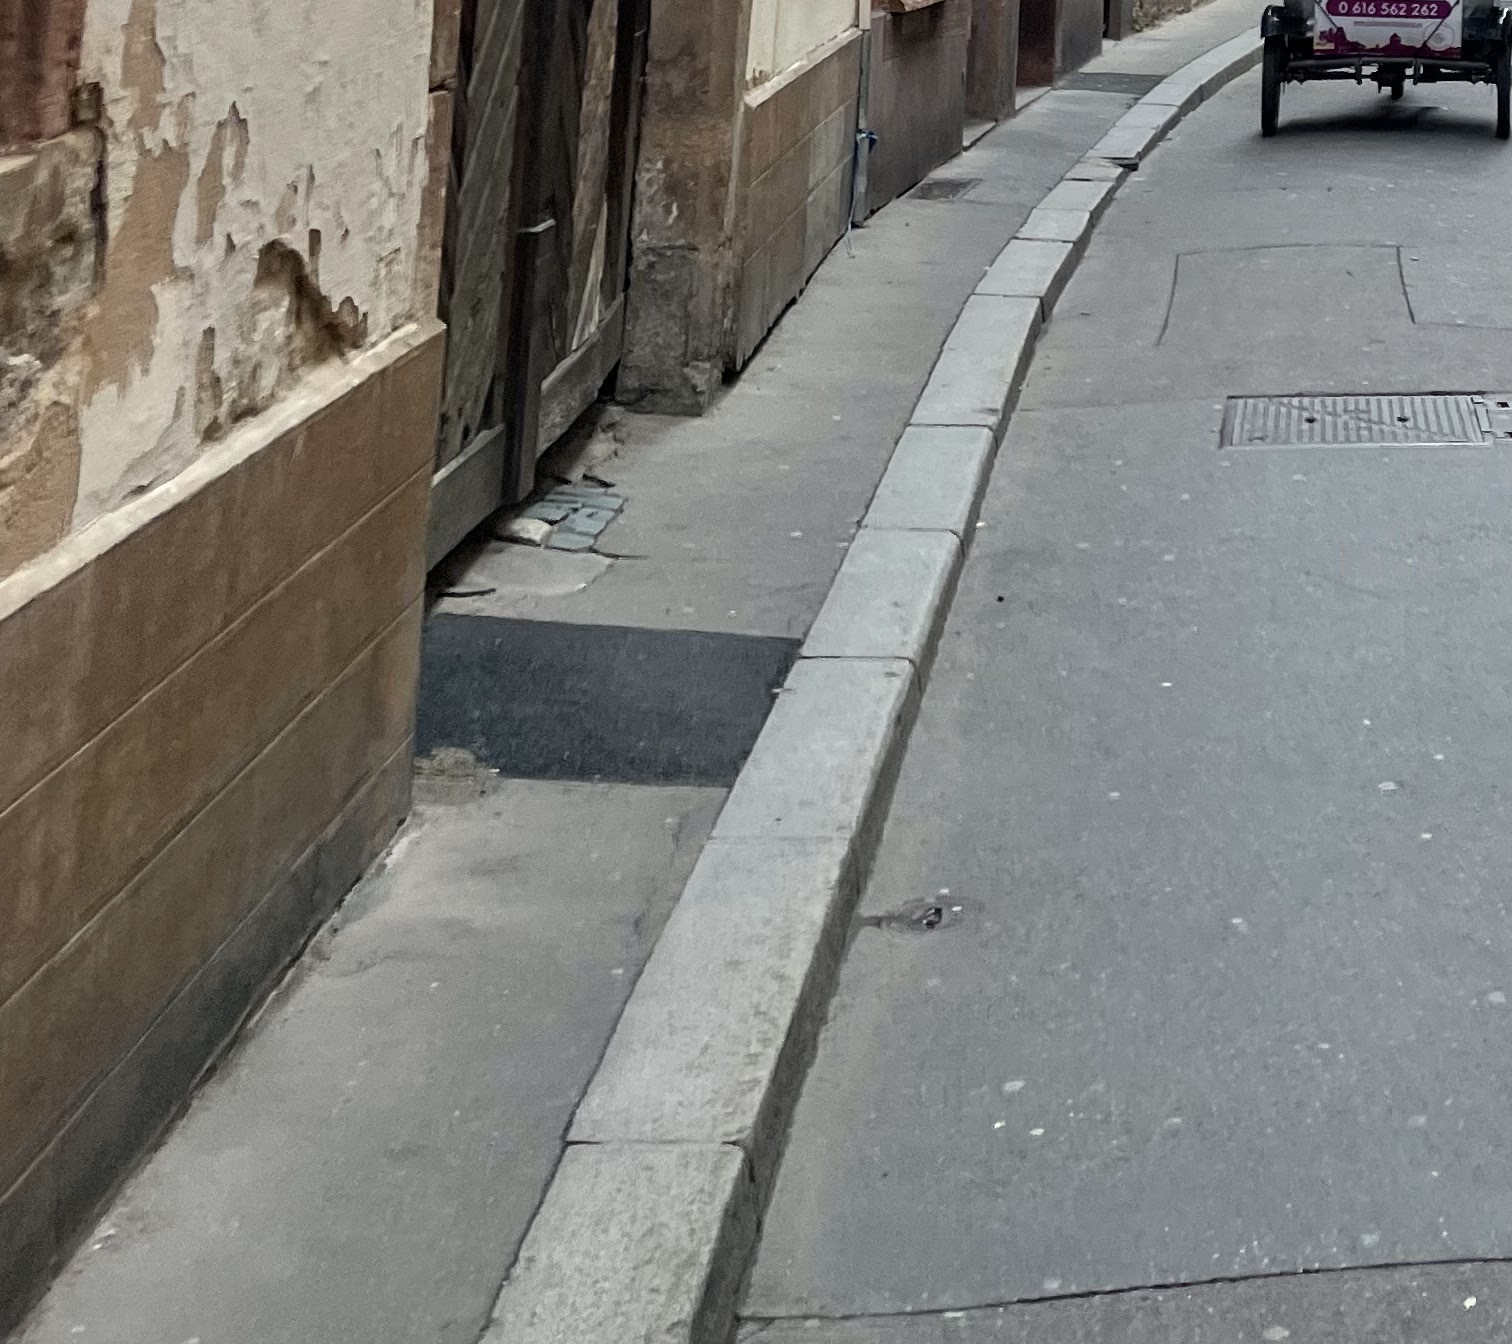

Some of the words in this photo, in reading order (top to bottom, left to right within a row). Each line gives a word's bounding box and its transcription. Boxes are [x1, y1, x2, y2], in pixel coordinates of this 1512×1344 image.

[1338, 1, 1348, 14] 0
[1352, 2, 1376, 15] 616
[1380, 2, 1407, 16] 562
[1411, 3, 1438, 16] 262
